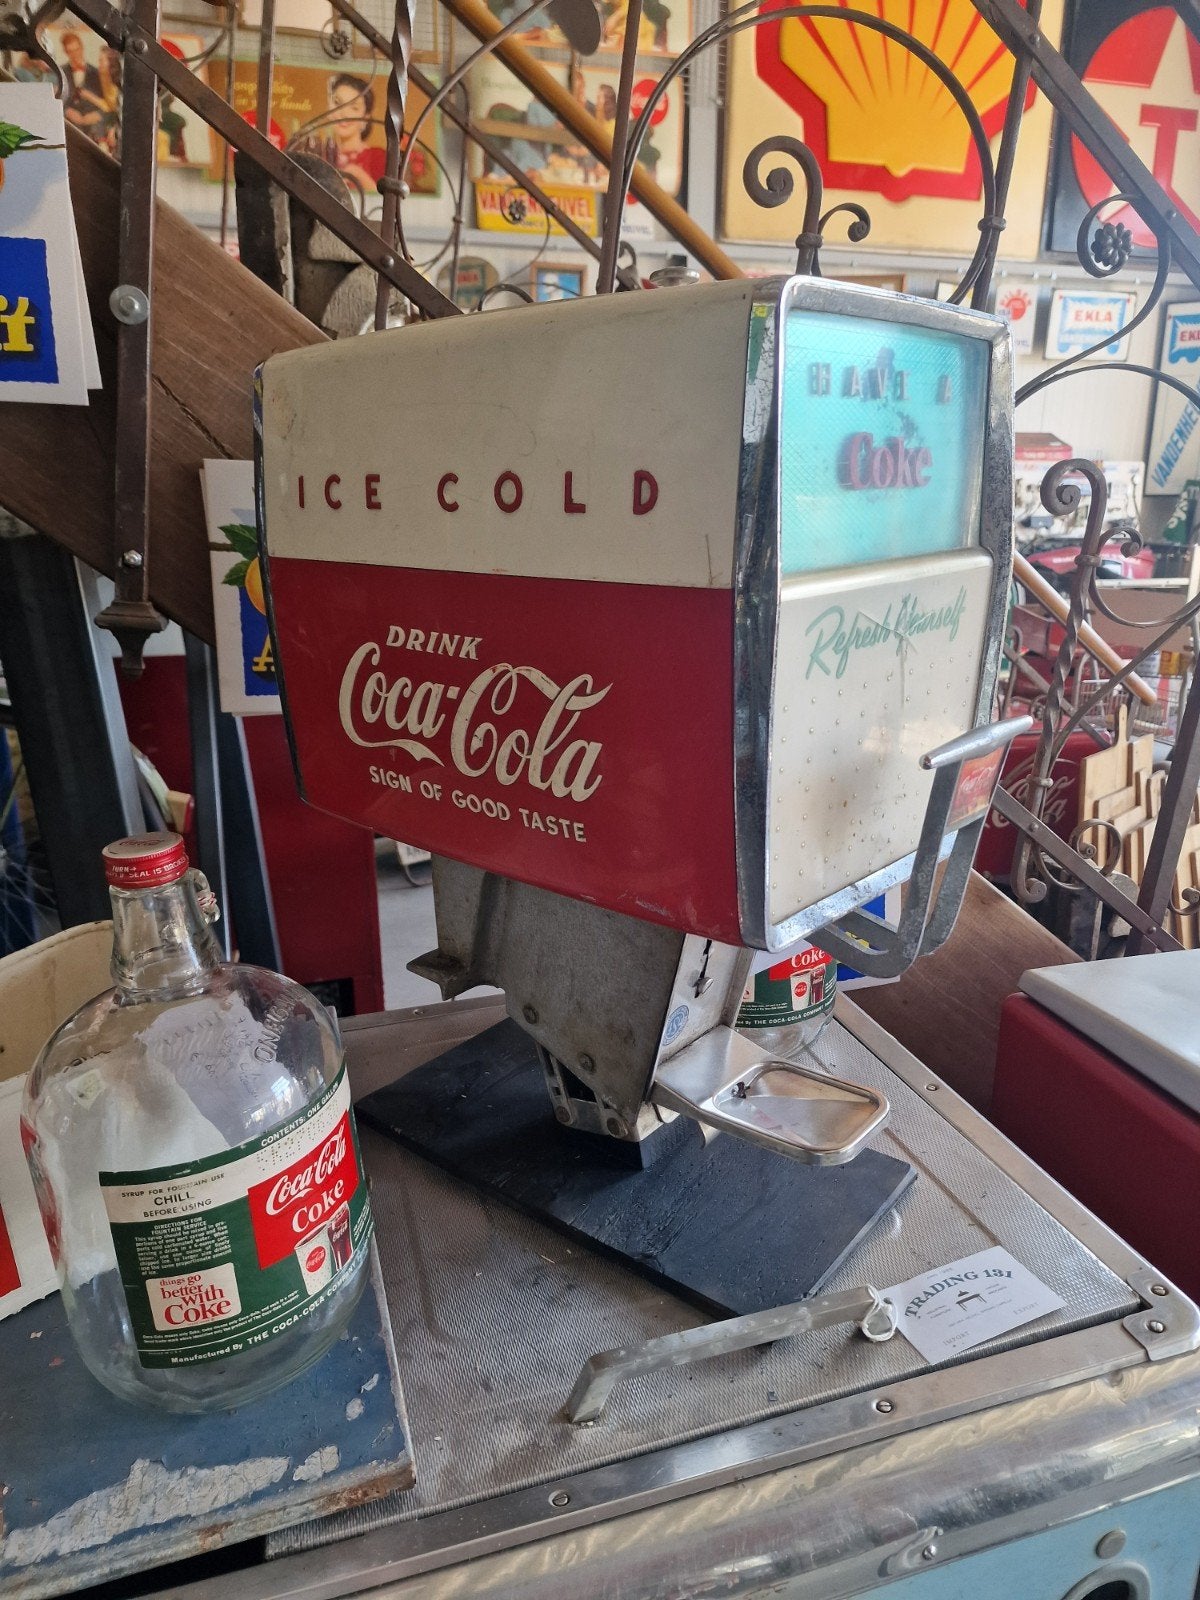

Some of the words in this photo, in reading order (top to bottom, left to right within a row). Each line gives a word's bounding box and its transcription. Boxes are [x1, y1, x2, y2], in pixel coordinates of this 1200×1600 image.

[1074, 309, 1113, 323] EKLA
[837, 431, 932, 491] Coke
[298, 473, 382, 510] ICE
[436, 469, 659, 516] COLD
[386, 624, 483, 661] DRINK
[805, 603, 892, 680] Refresh
[893, 584, 967, 657] Yourself
[338, 641, 613, 803] Coca-Cola
[368, 765, 413, 793] SIGN
[420, 780, 443, 801] OF
[451, 789, 511, 821] GOOD
[519, 807, 588, 843] TASTE
[791, 949, 826, 968] Coke
[307, 1103, 321, 1118] ONE
[265, 1119, 346, 1216] Coca-Cola
[121, 1190, 145, 1198] SYRUP
[148, 1188, 163, 1196] FOR
[211, 1172, 225, 1182] USE
[153, 1191, 195, 1206] CHILL
[143, 1206, 178, 1218] BEFORE
[181, 1198, 212, 1212] USING
[292, 1179, 344, 1233] Coke
[159, 1277, 186, 1287] things
[187, 1274, 201, 1286] go
[160, 1285, 204, 1299] better
[181, 1284, 225, 1306] with
[904, 1269, 980, 1318] TRADING
[164, 1300, 232, 1325] Coke
[171, 1346, 231, 1363] Manufactured
[232, 1343, 244, 1351] By
[247, 1330, 270, 1345] THE
[272, 1294, 326, 1334] COCA-COLA
